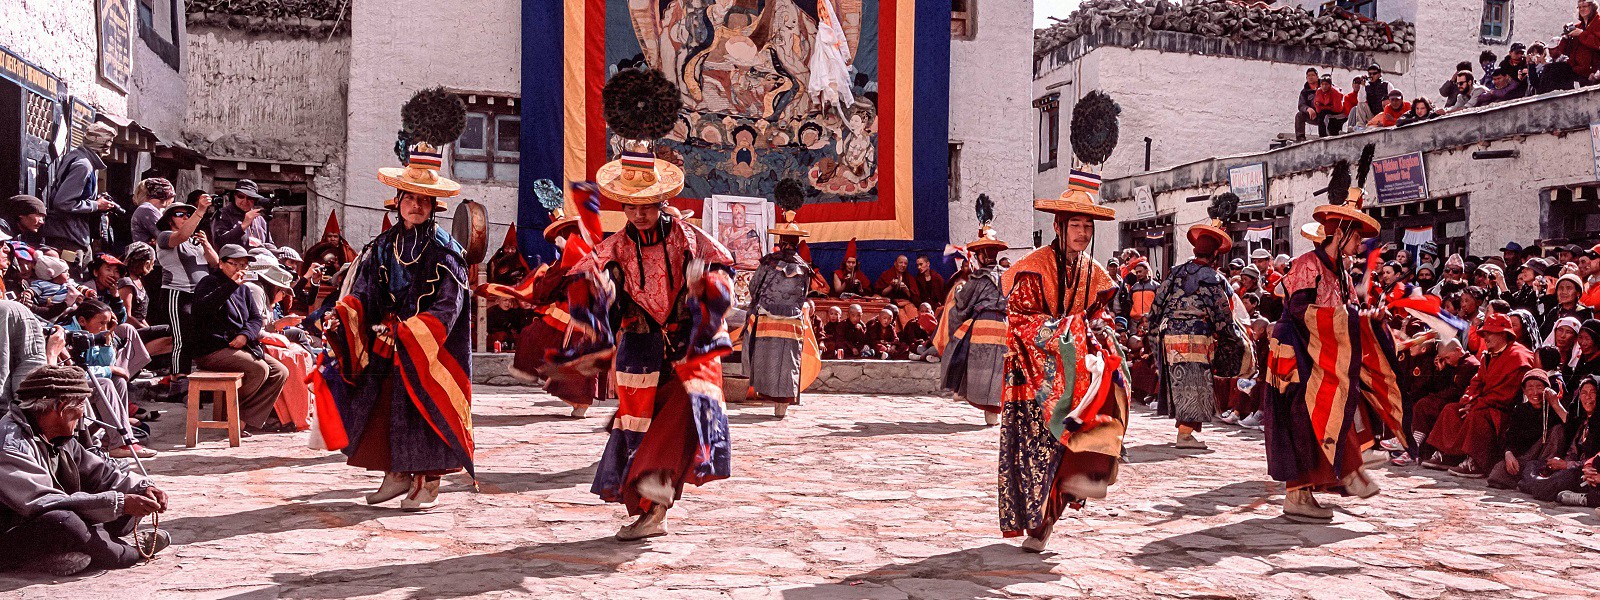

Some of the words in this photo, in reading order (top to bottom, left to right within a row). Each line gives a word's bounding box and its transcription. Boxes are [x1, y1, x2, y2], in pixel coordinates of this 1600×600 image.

[1372, 161, 1382, 173] The
[1382, 159, 1398, 172] Hidden
[1399, 156, 1419, 170] Kingdom
